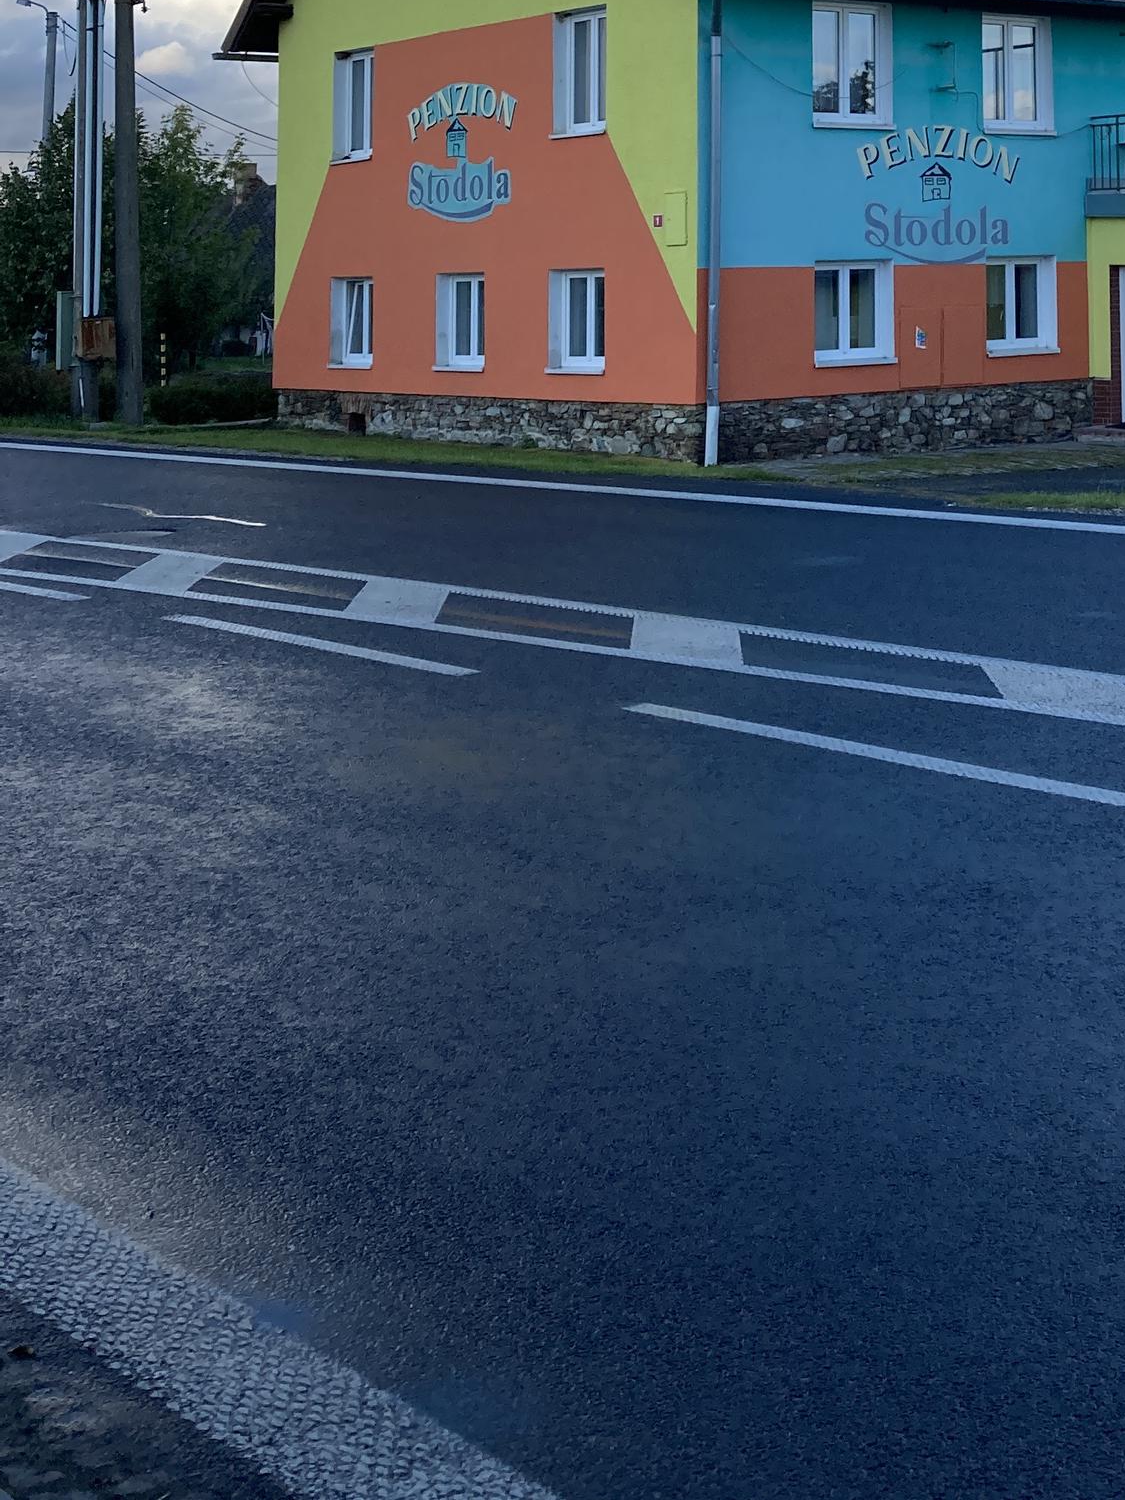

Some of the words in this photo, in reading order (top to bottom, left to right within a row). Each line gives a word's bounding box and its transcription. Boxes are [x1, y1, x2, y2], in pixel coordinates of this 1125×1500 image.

[407, 83, 518, 141] PENZION
[857, 125, 1020, 184] PENZION
[409, 161, 510, 205] Stodola
[865, 203, 1009, 247] Stodola
